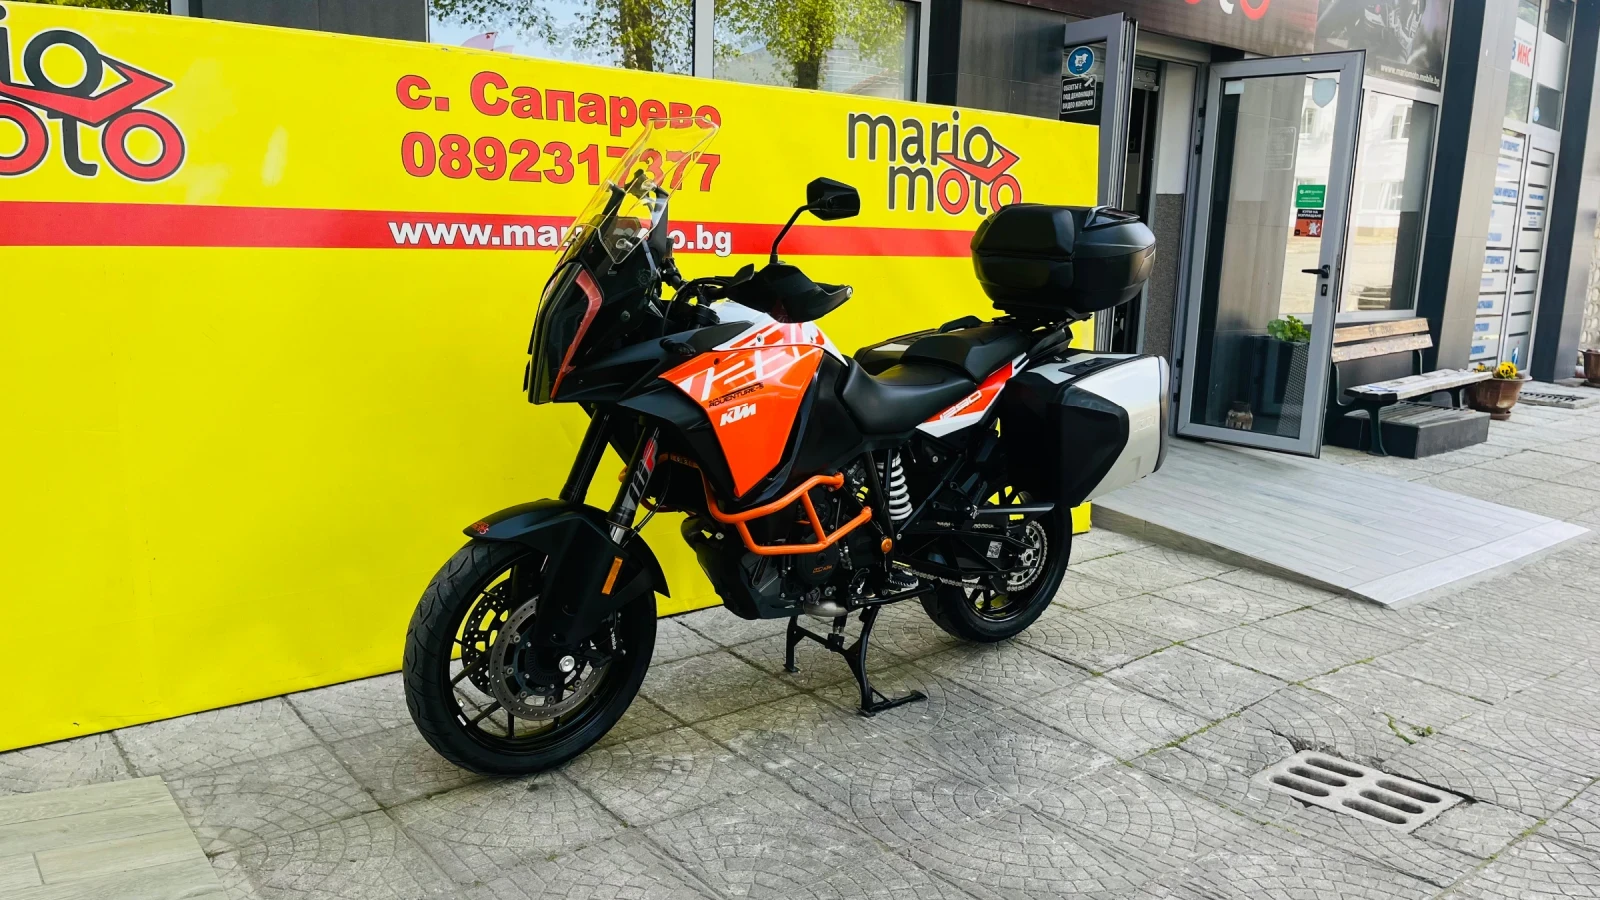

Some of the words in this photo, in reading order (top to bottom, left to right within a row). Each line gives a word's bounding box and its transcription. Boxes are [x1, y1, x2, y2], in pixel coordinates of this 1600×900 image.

[395, 74, 450, 111] с.
[469, 70, 722, 137] Сапарево
[400, 131, 721, 192] 0892317377
[848, 110, 994, 167] mario
[888, 165, 1022, 215] moto
[719, 402, 757, 427] KTM
